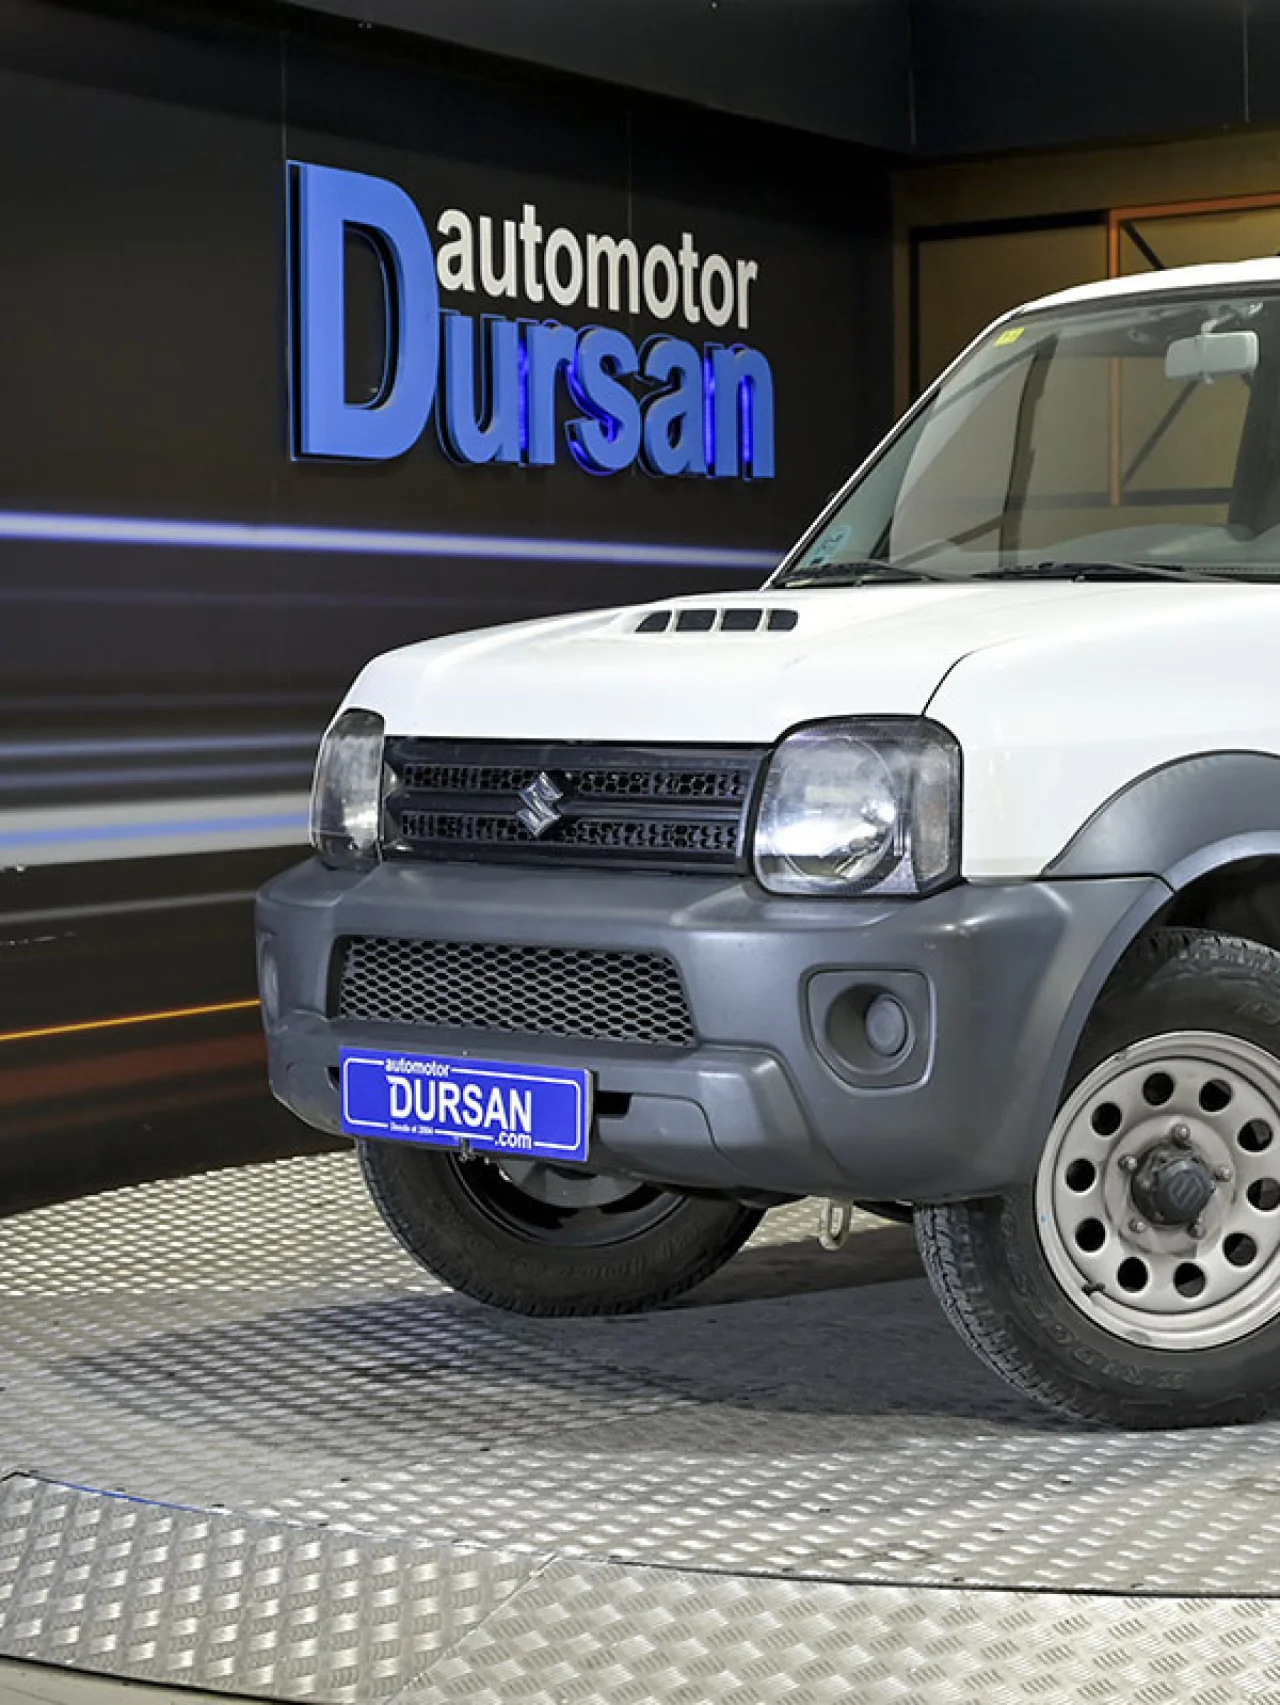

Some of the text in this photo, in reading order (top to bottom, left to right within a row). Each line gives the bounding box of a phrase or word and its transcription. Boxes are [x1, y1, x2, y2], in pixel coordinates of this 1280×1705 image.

[436, 203, 758, 330] automotor
[286, 159, 776, 480] Dursan
[385, 1057, 450, 1078] automotor
[386, 1075, 532, 1133] DURSAN
[494, 1131, 532, 1149] .com
